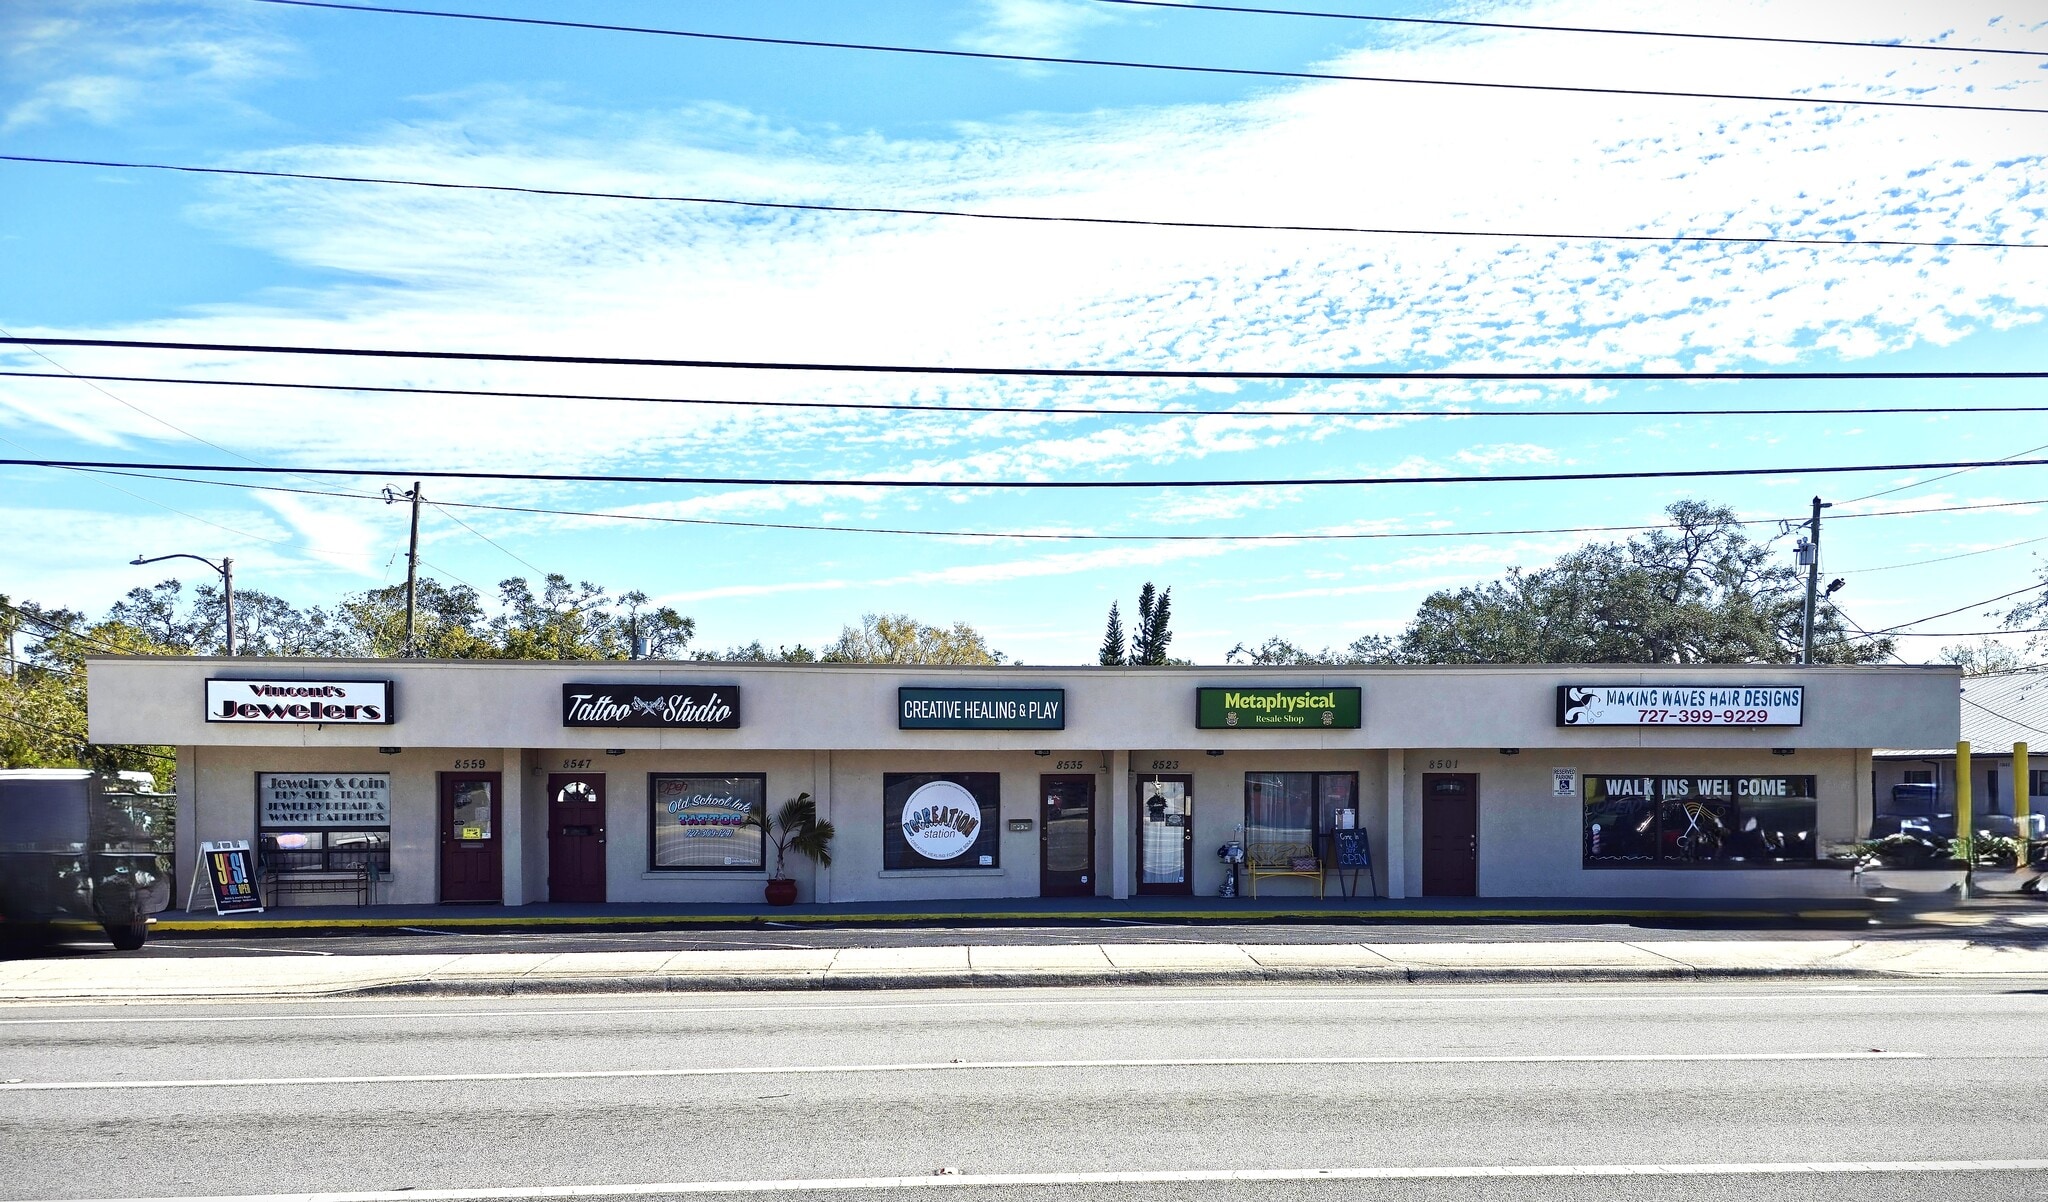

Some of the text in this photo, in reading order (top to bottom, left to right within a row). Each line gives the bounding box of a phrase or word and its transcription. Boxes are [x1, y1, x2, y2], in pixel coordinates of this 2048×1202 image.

[248, 684, 346, 698] Vincent's
[1225, 692, 1335, 713] Metaphysical
[1606, 689, 1800, 707] MAKING WAVES HAIR DESIGNS
[213, 700, 381, 719] Jewelers
[568, 693, 732, 722] Tattoo Studio
[904, 700, 1059, 719] CREATIVE HEALING & PLAY
[1256, 715, 1304, 724] Resale Shop
[1638, 709, 1768, 723] 727-399-9229
[454, 759, 486, 769] 8559
[562, 759, 592, 769] 8547
[1056, 760, 1083, 770] 8535
[1152, 760, 1179, 770] 8523
[1429, 760, 1459, 769] 8501
[267, 777, 386, 789] Jewelry & Coin
[1606, 779, 1654, 796] WALK
[1661, 779, 1689, 796] INS
[265, 802, 324, 811] JEWELRY
[325, 802, 373, 810] REPAIR
[668, 794, 752, 813] Old School Ink
[269, 813, 385, 822] WATCH BATTERIES
[678, 814, 742, 826] TATTOO
[923, 829, 956, 839] station
[1342, 853, 1367, 865] OPEN
[214, 852, 248, 885] YES!
